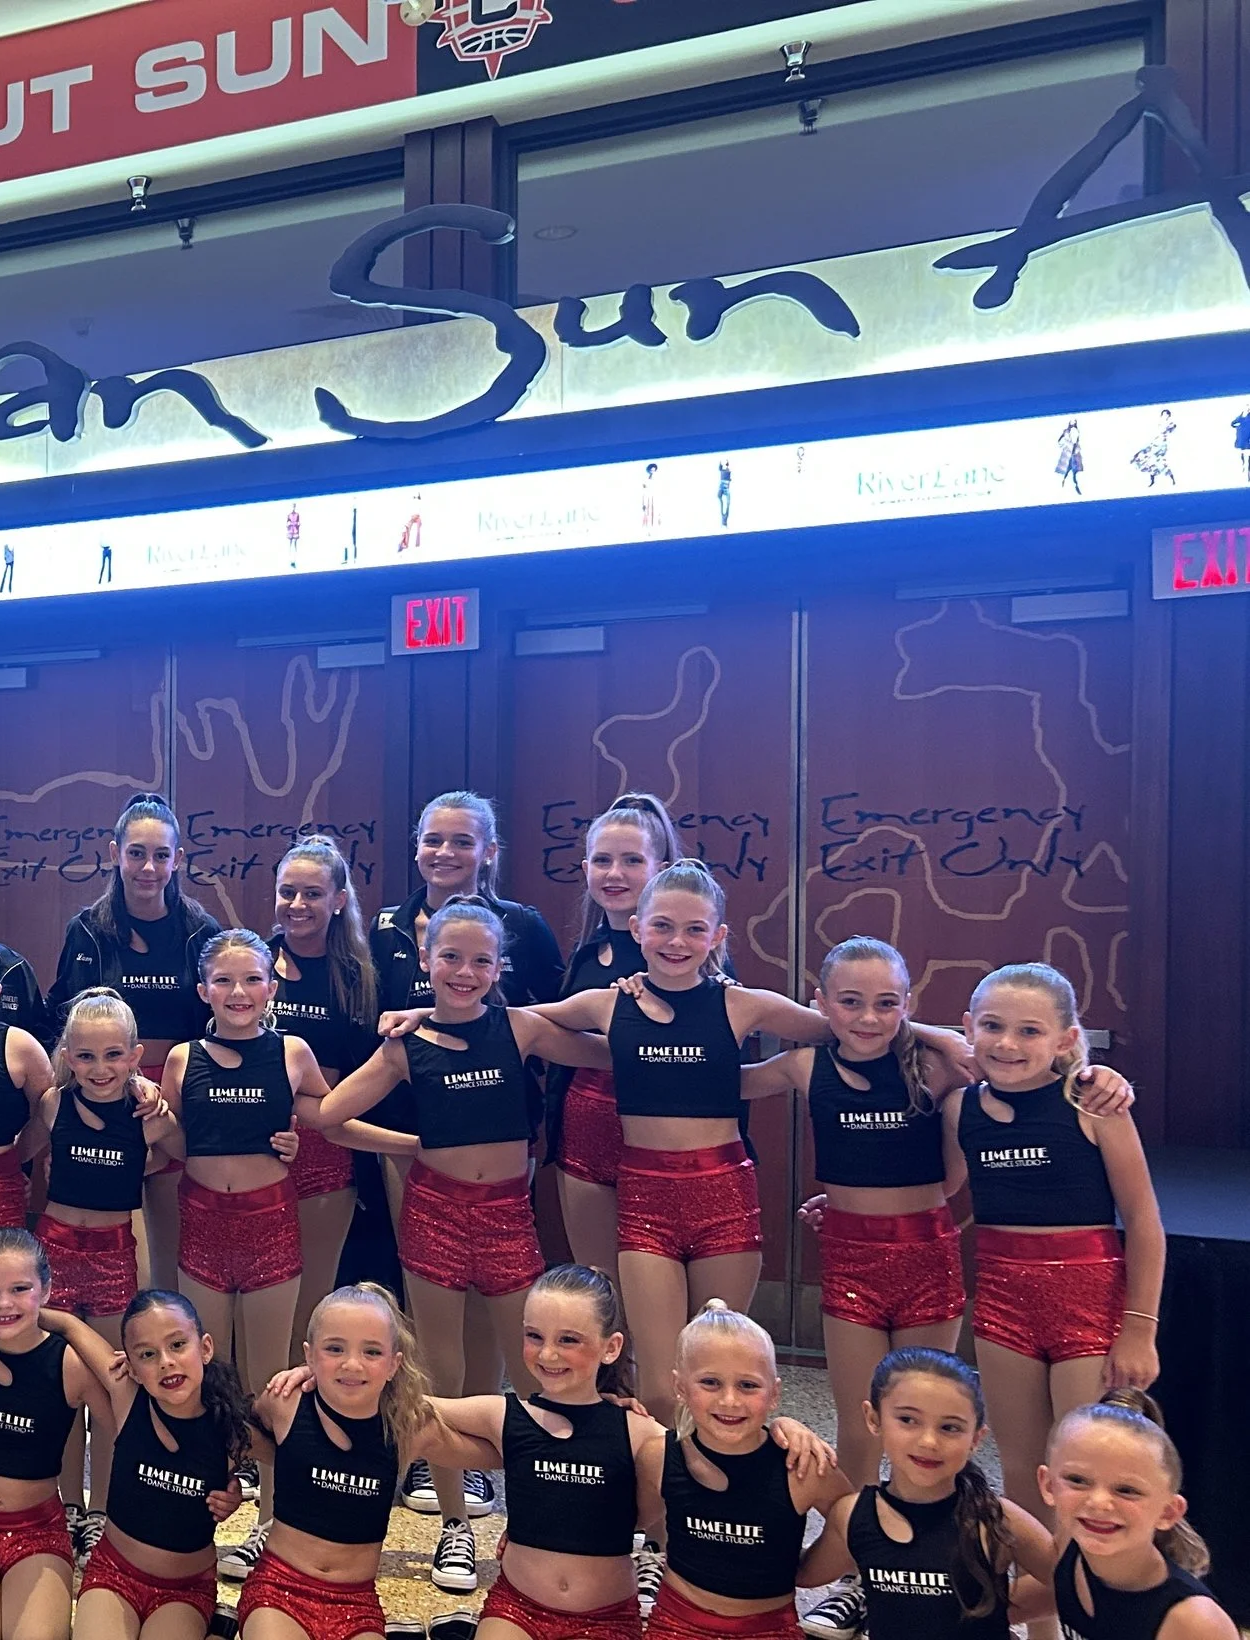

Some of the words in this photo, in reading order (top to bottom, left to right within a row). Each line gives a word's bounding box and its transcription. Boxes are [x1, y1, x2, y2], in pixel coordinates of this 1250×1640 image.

[133, 0, 388, 113] SUN
[314, 203, 861, 440] Sun
[406, 596, 469, 649] EXIT
[542, 800, 769, 840] Emency
[821, 793, 1088, 836] Emergency
[186, 810, 377, 848] Emergency
[820, 836, 925, 882] Exit
[940, 829, 1088, 879] Only
[186, 849, 263, 886] Exit
[122, 975, 180, 985] LIMELITE
[638, 1046, 705, 1057] LIMELITE
[648, 1056, 673, 1064] DANCE
[673, 1056, 698, 1064] STUDIO
[443, 1068, 503, 1085] LIMELITE
[454, 1080, 476, 1091] DANCE
[475, 1077, 499, 1089] STUDIO
[209, 1087, 265, 1098] LIMELITE
[238, 1096, 259, 1104] STUDIO
[839, 1111, 907, 1124] LIMELITE
[850, 1122, 875, 1131] DANCE
[874, 1121, 900, 1130] STUDIO
[70, 1145, 124, 1161] LIMELITE
[77, 1156, 97, 1165] DANCE
[97, 1157, 118, 1167] STUDIO
[980, 1147, 1049, 1163] LIMELITE
[990, 1159, 1014, 1169] DANCE
[1014, 1157, 1042, 1168] STUDIO
[4, 1421, 27, 1434] STUDIO
[534, 1459, 604, 1478] LIMELITE
[138, 1463, 206, 1492] LIMELITE
[311, 1467, 381, 1491] LIMELITE
[544, 1472, 570, 1484] DANCE
[570, 1474, 597, 1486] STUDIO
[146, 1477, 172, 1491] DANCE
[171, 1483, 197, 1498] STUDIO
[321, 1480, 347, 1494] DANCE
[346, 1484, 373, 1497] STUDIO
[686, 1516, 764, 1538] LIMELITE
[696, 1529, 725, 1543] DANCE
[724, 1533, 755, 1546] STUDIO
[868, 1567, 950, 1588] LIMELITE
[879, 1582, 910, 1595] DANCE
[910, 1584, 943, 1597] STUDIO
